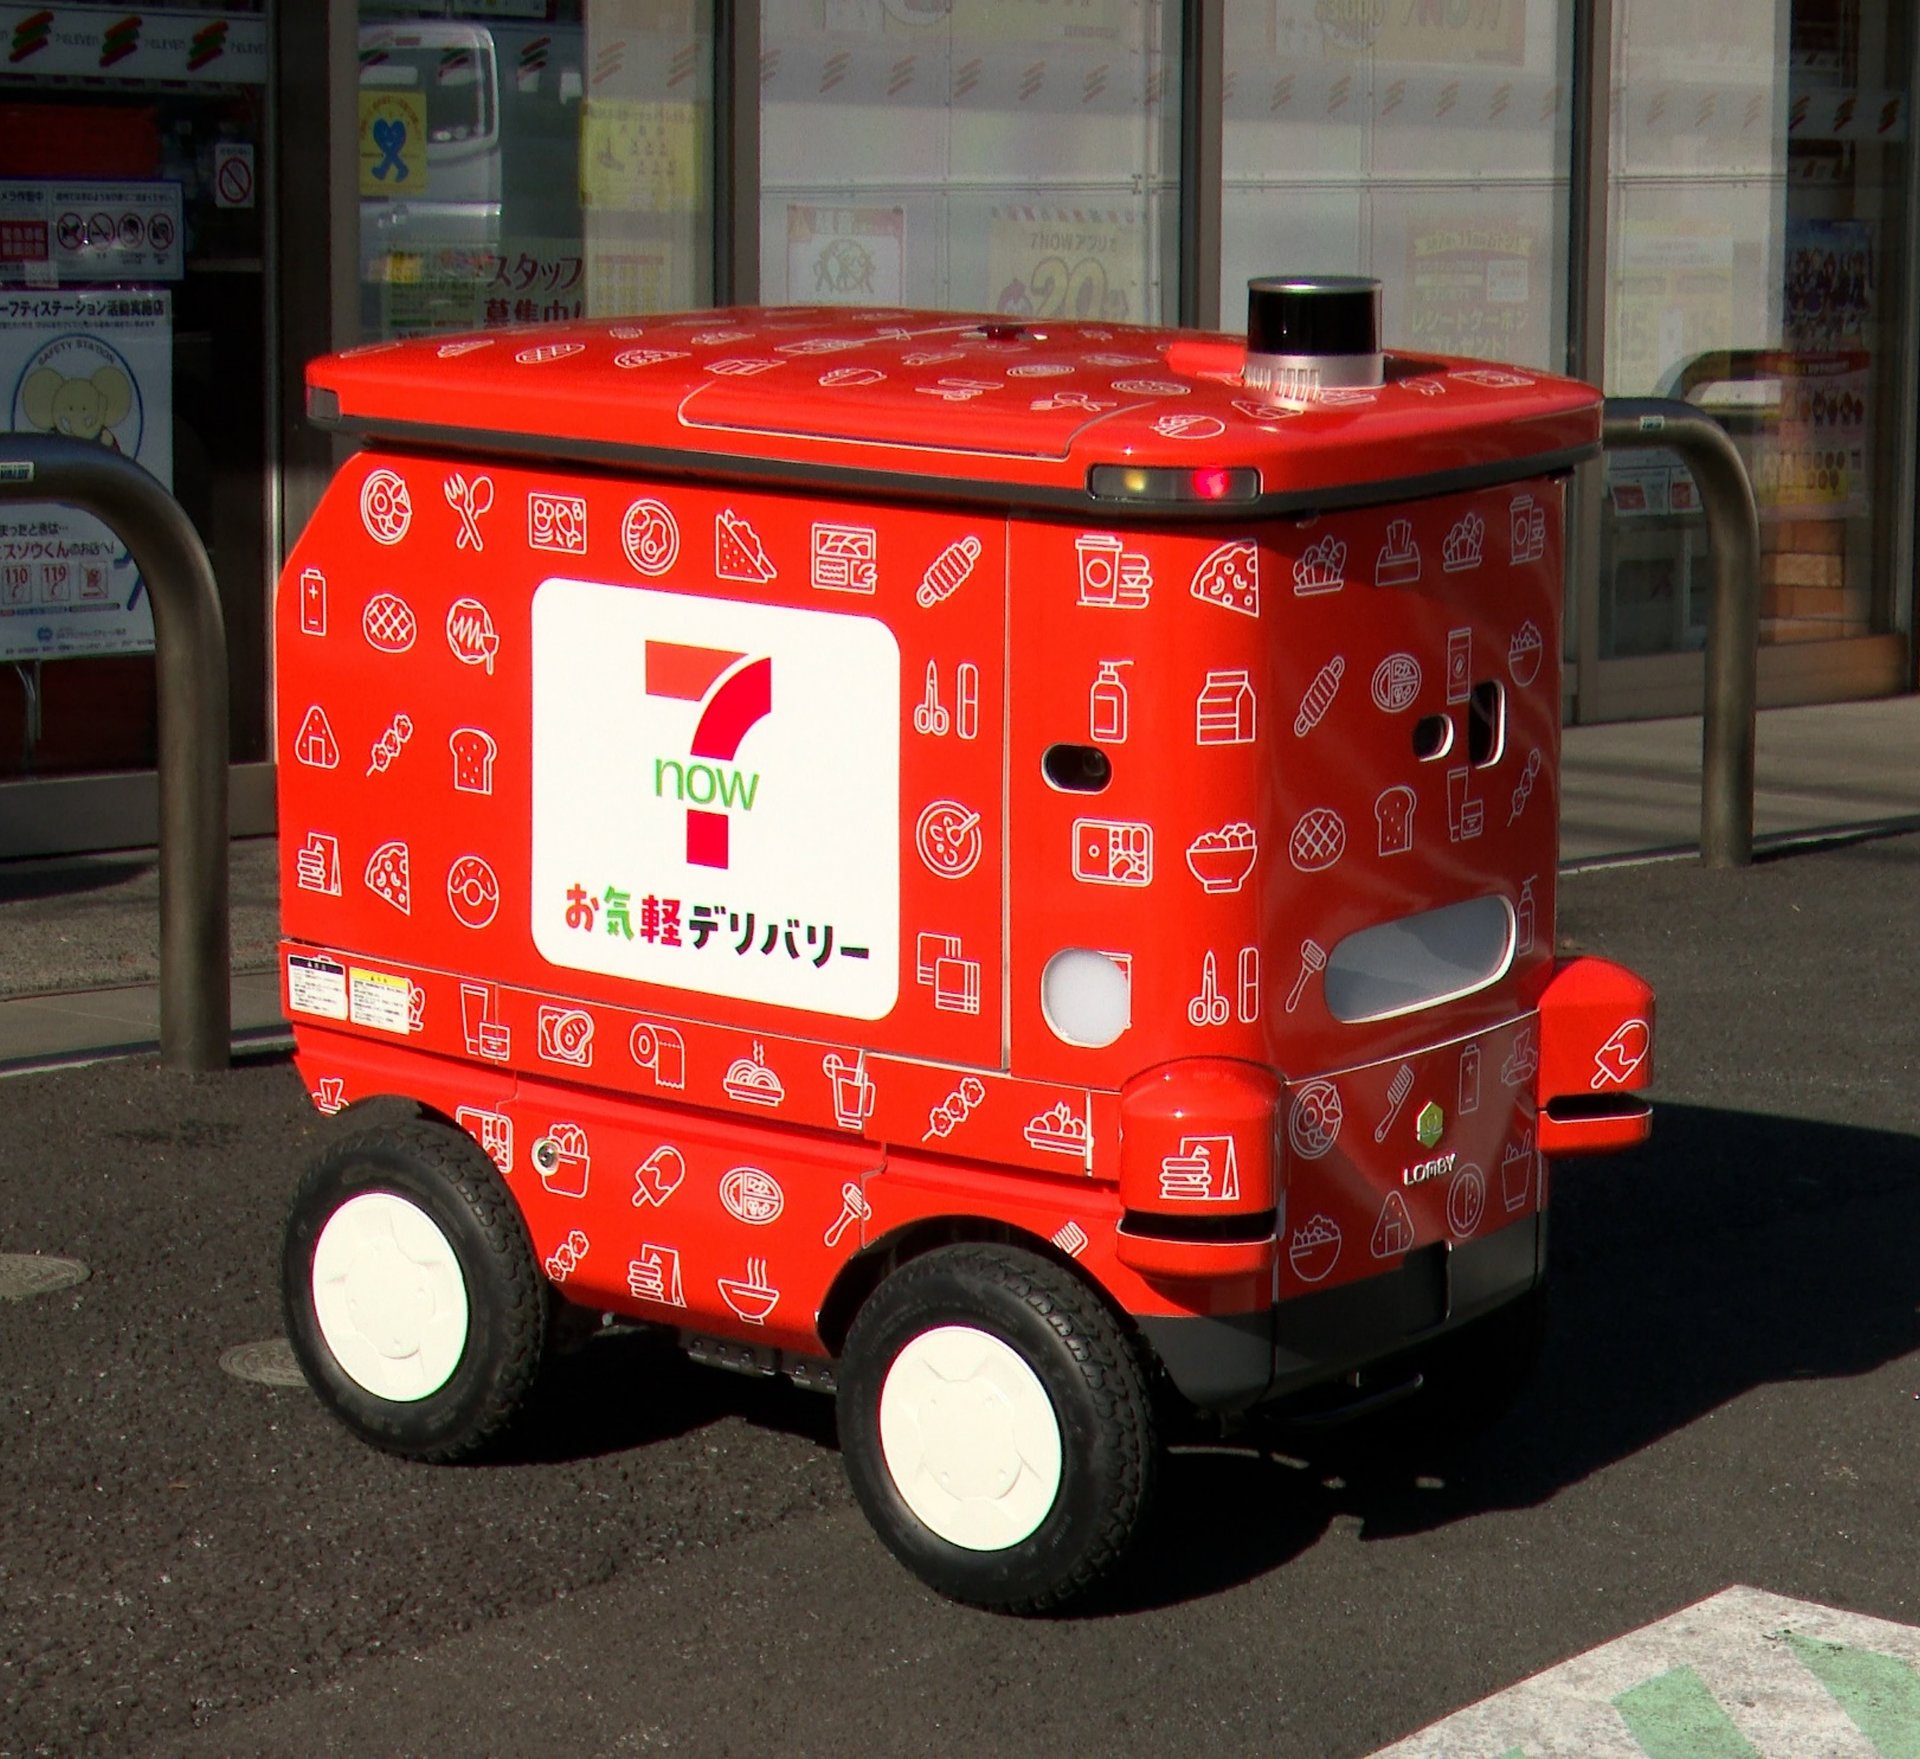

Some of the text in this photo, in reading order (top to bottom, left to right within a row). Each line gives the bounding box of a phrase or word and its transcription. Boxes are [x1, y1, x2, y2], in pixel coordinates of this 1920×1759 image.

[486, 252, 584, 291] スタッフ
[6, 566, 67, 584] 110 119
[655, 758, 760, 811] now
[565, 883, 870, 969] お気軽デリバリー
[1403, 1152, 1457, 1186] LOMBY
